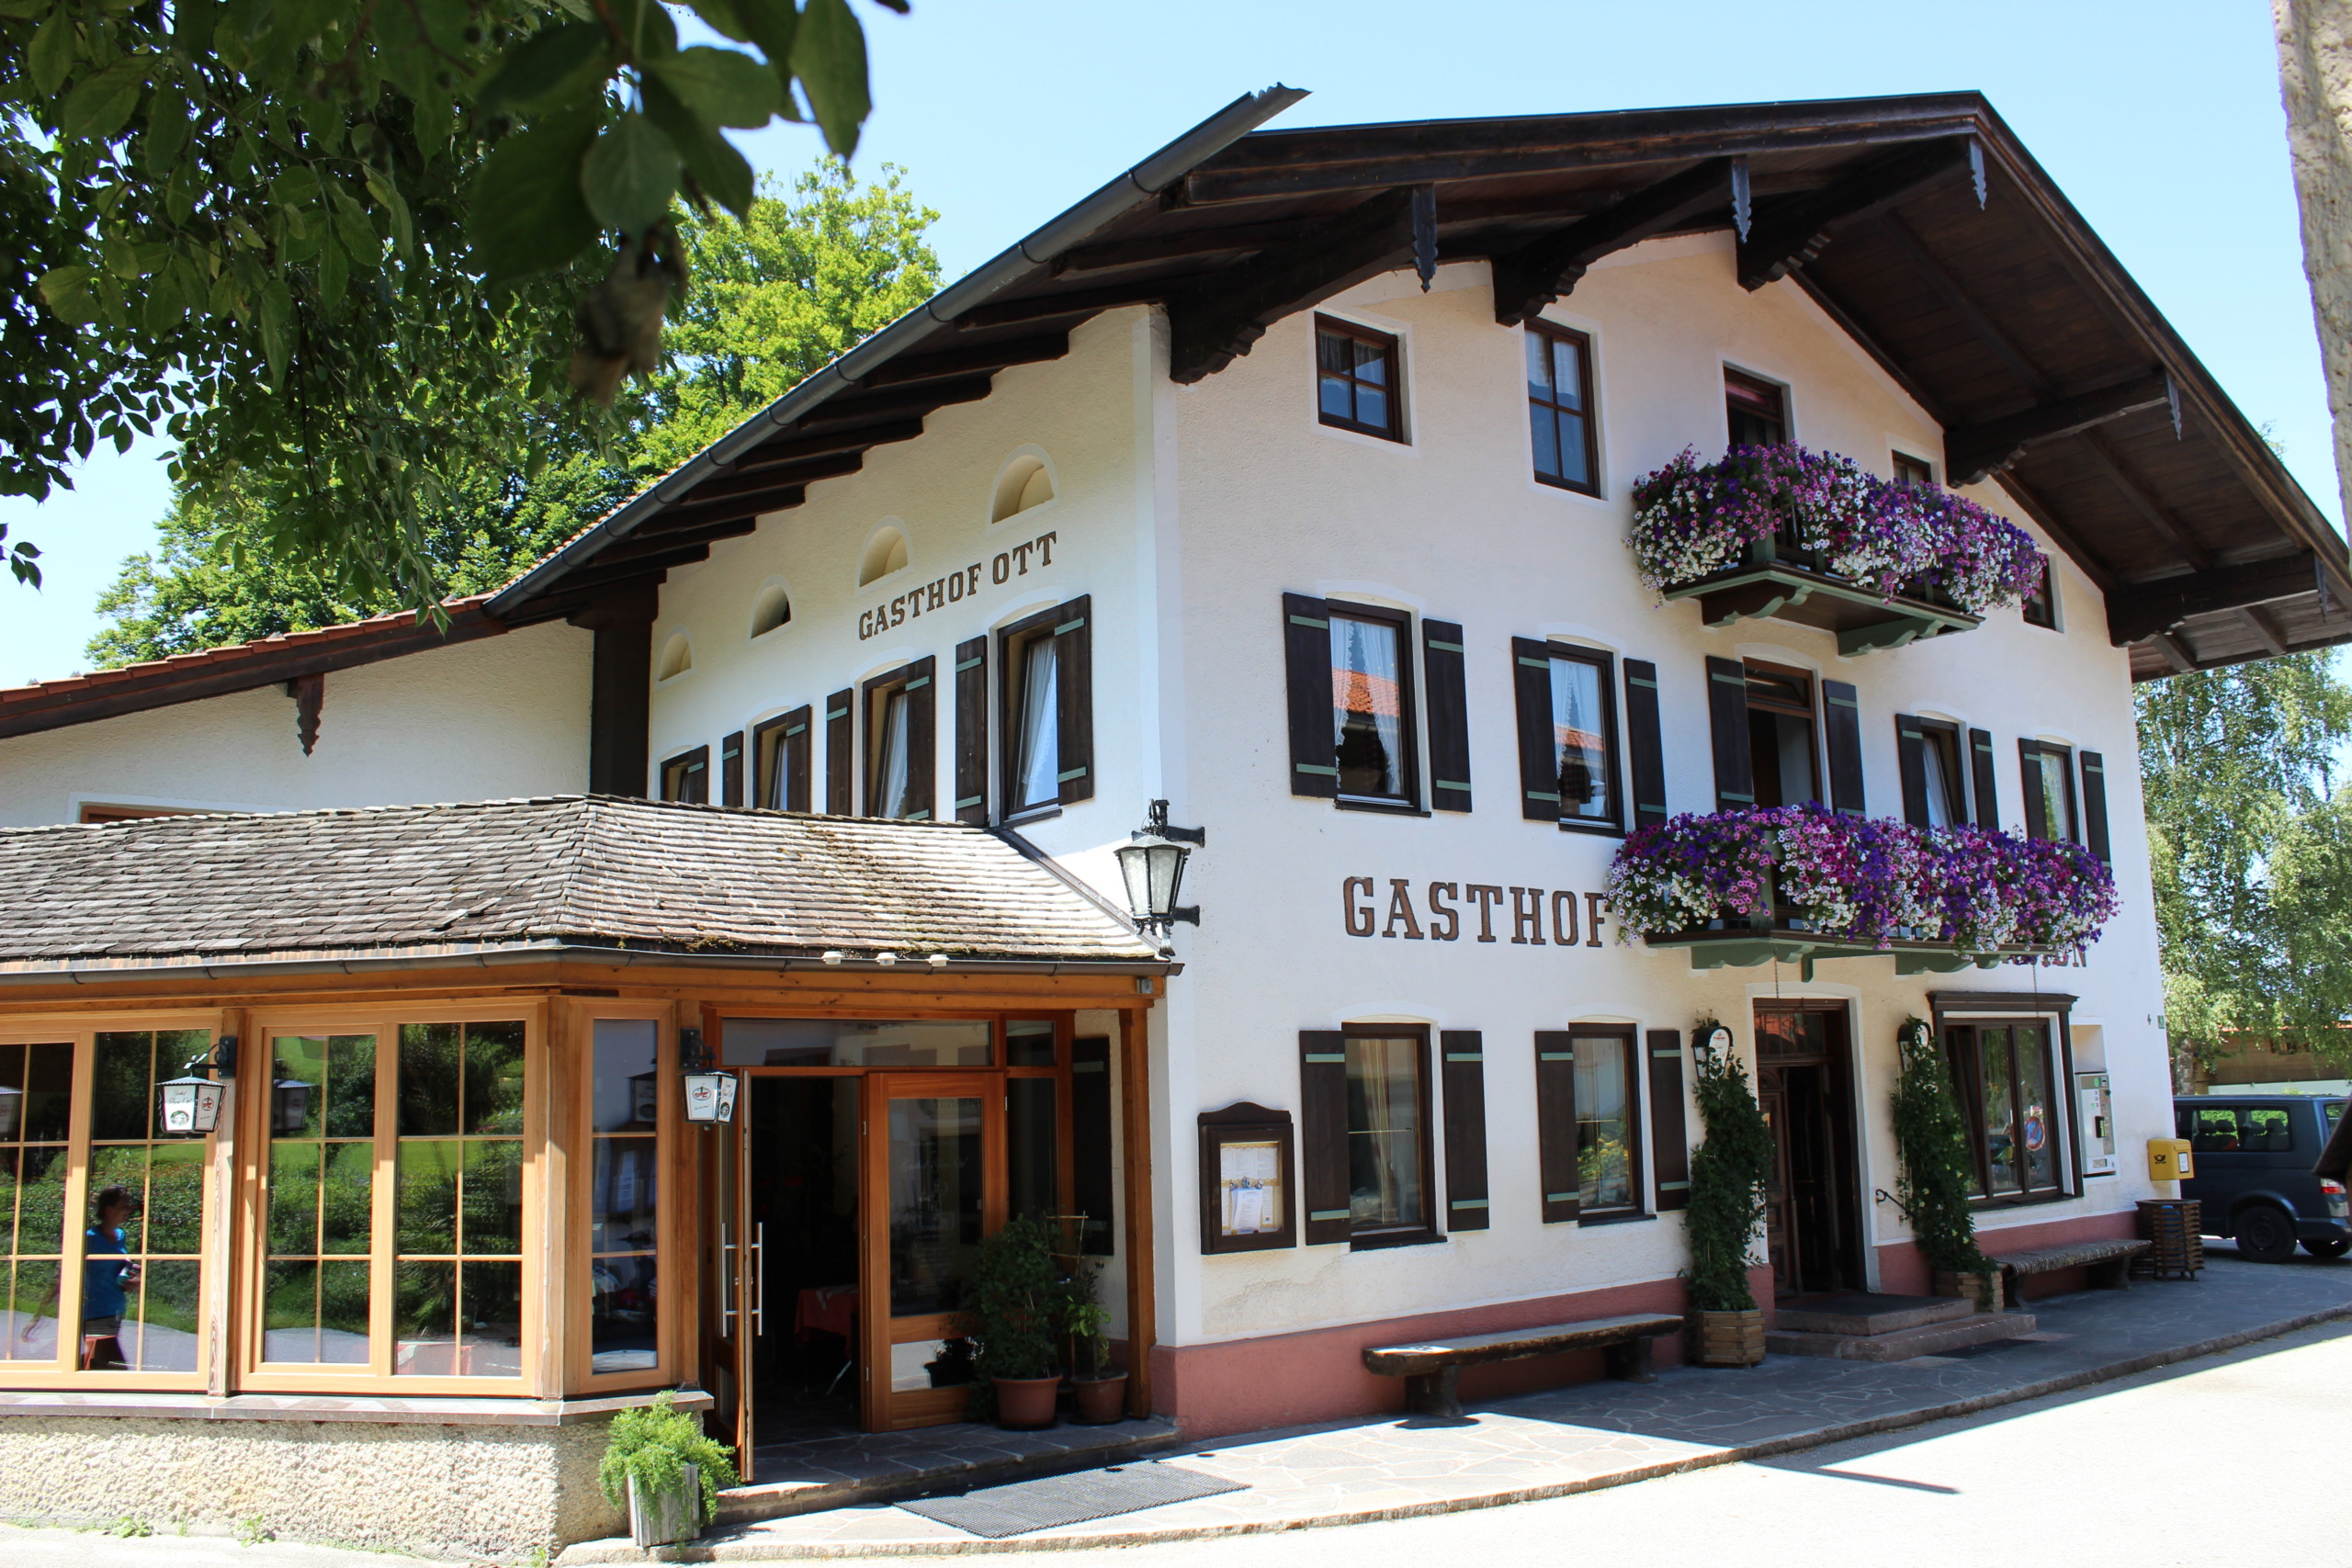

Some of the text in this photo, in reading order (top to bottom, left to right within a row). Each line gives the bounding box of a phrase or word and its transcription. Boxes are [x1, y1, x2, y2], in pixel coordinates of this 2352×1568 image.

[859, 531, 1057, 641] GASTHOF OTT
[1342, 875, 1612, 948] GASTHOF
